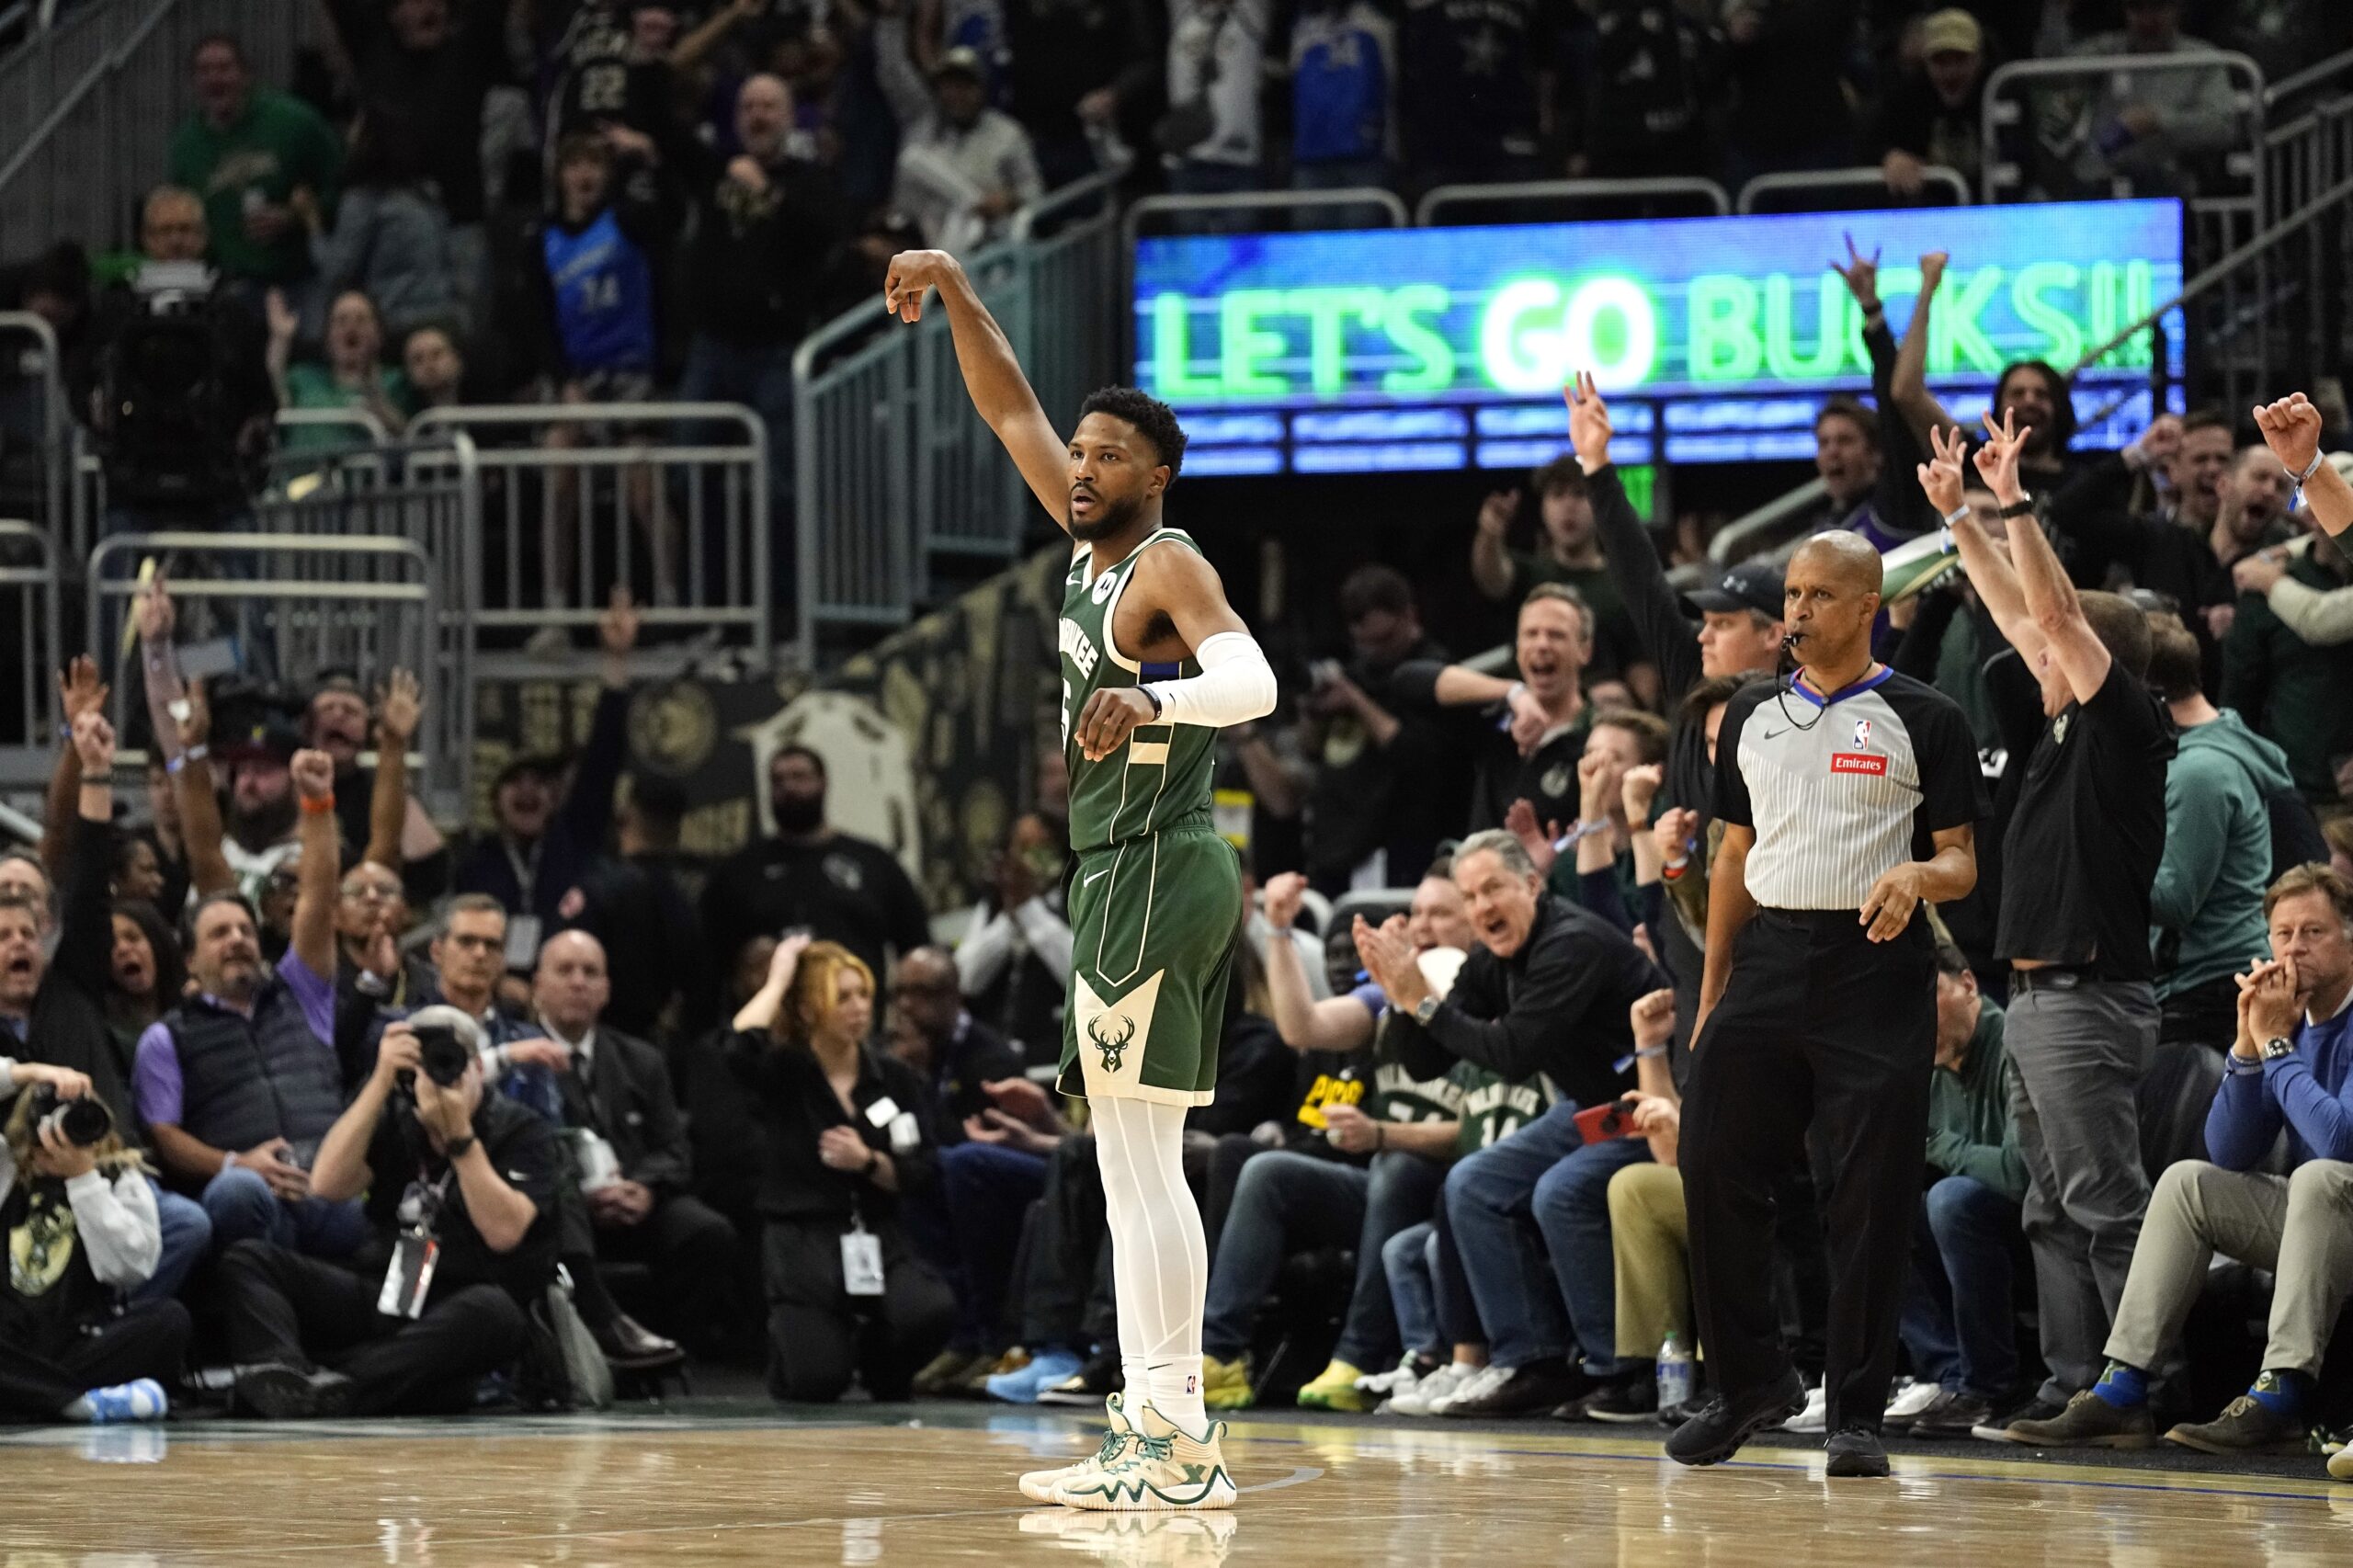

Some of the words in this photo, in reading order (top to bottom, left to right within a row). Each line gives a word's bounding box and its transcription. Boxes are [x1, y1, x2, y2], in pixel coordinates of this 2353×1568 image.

[1154, 284, 1455, 399] LET'S
[1481, 275, 1656, 392] GO
[1836, 757, 1881, 771] Emirates
